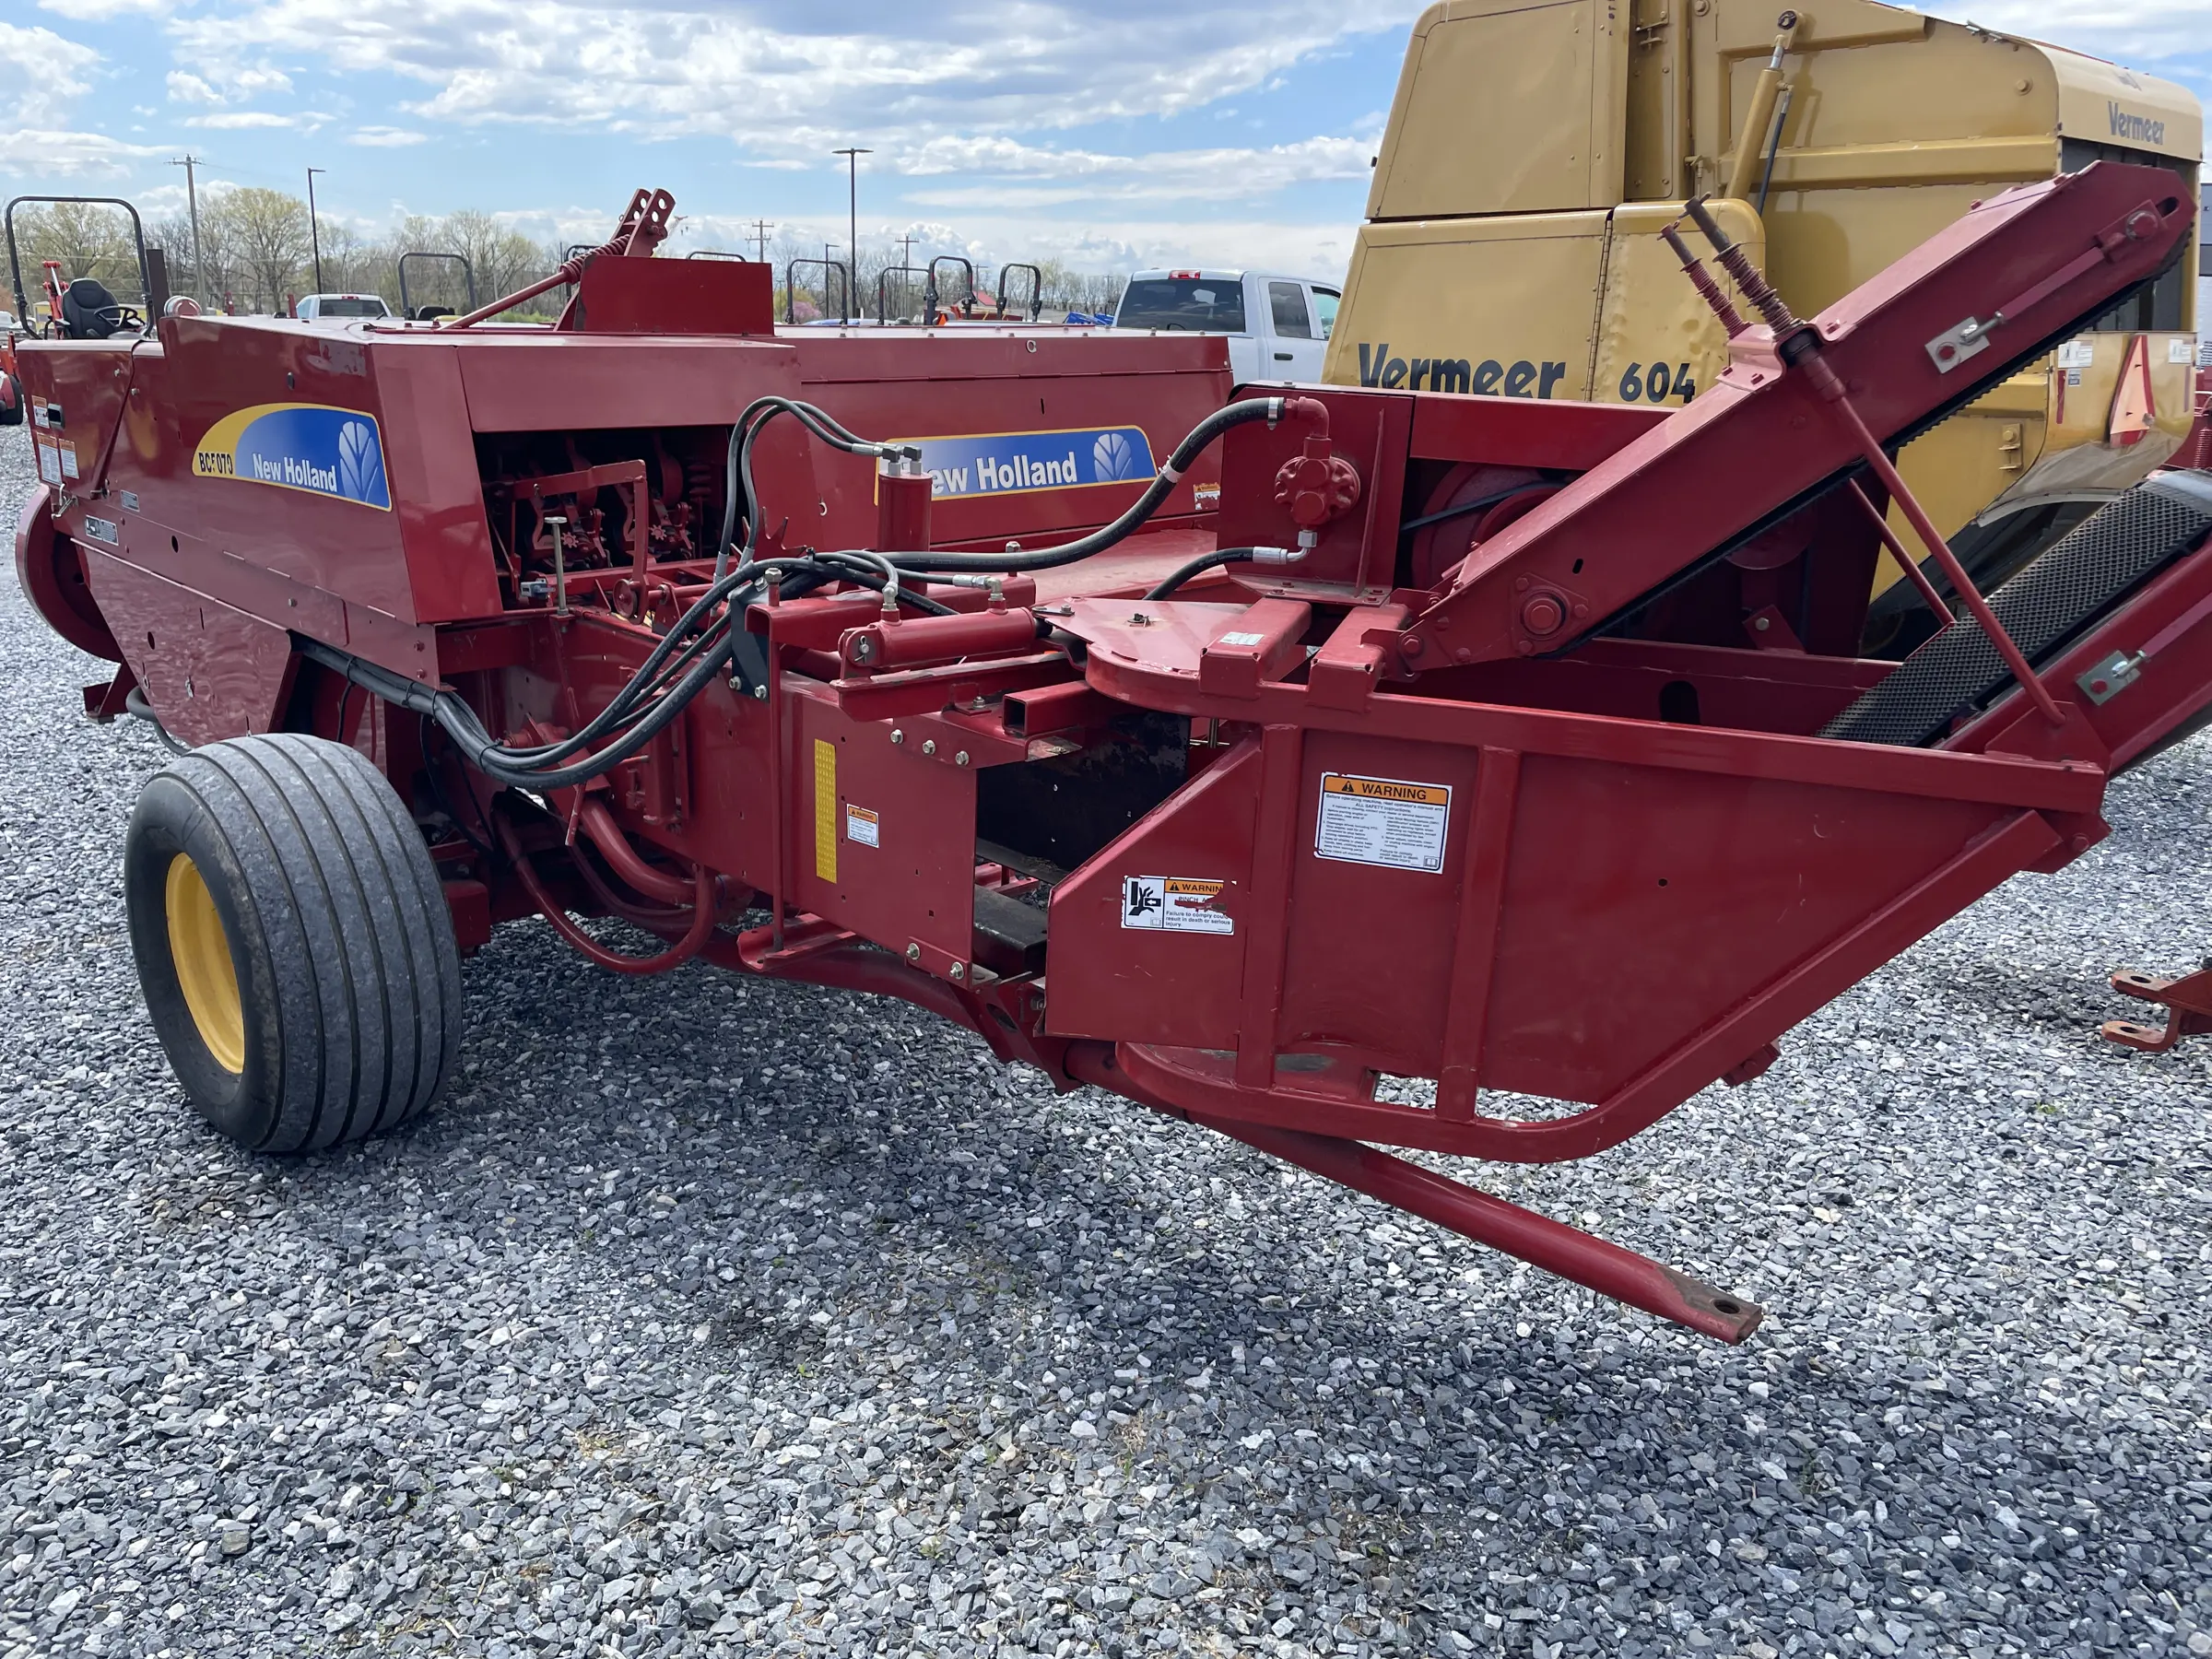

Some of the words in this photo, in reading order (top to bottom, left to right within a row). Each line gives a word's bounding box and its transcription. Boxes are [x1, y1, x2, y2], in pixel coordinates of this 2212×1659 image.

[2108, 100, 2164, 145] Vermeer
[1359, 344, 1565, 399] Vermeer
[1619, 362, 1695, 403] 604
[253, 453, 281, 482] New
[283, 457, 337, 492] Holland
[976, 452, 1077, 490] Holland
[1362, 783, 1427, 800] WARNING
[1182, 883, 1222, 893] WARNIN
